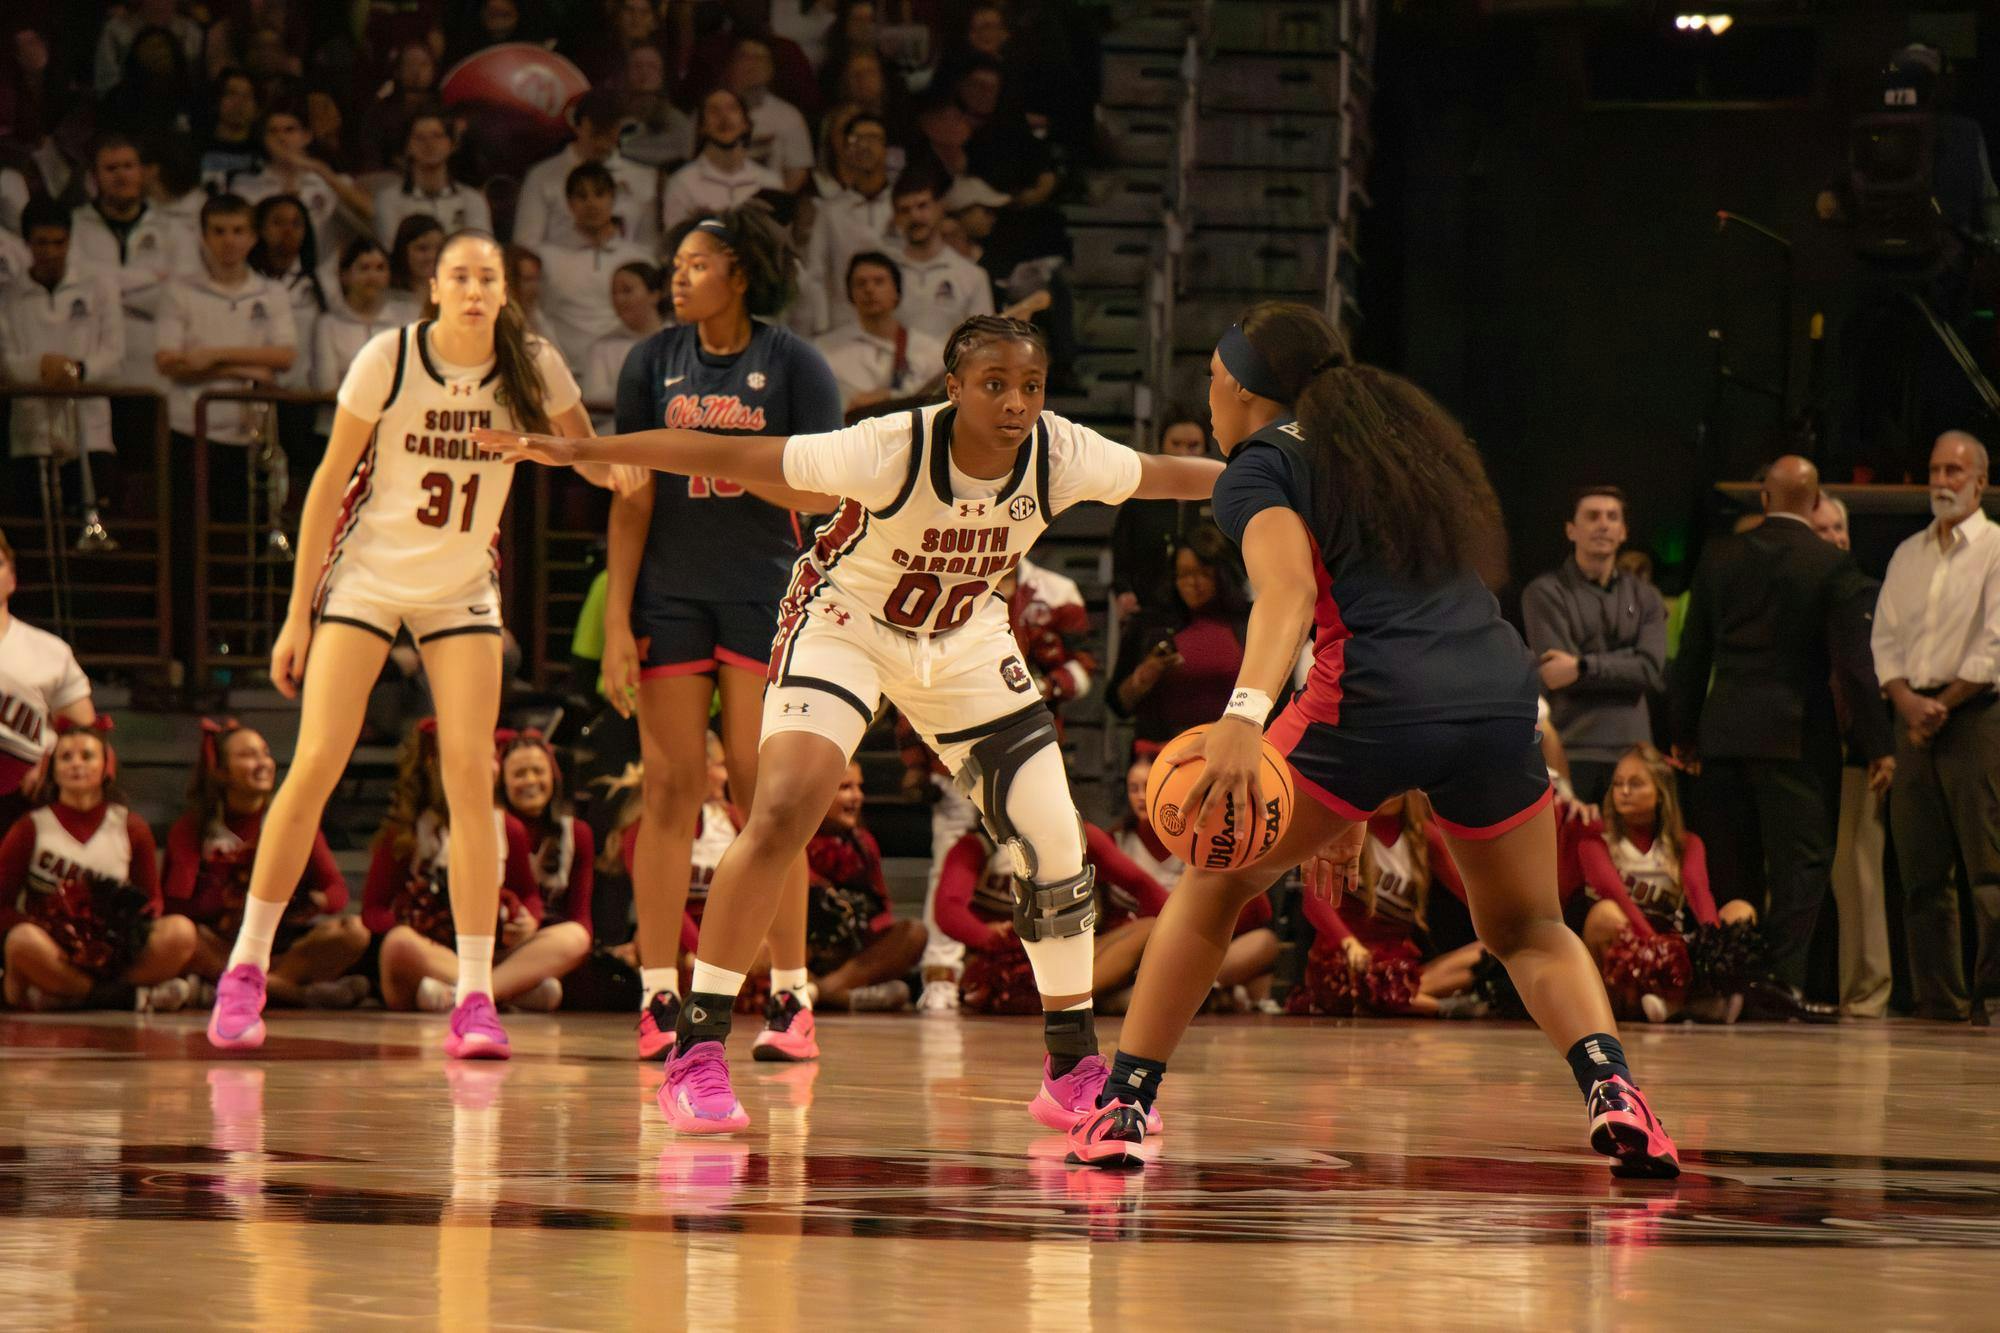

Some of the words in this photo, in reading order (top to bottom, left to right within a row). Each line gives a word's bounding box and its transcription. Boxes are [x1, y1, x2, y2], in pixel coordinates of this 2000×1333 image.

[425, 410, 491, 432] SOUTH
[665, 394, 704, 429] Ole
[701, 394, 767, 431] Miss
[417, 472, 480, 532] 31
[1010, 497, 1034, 520] SEC
[921, 527, 1010, 553] SOUTH
[883, 572, 990, 630] 00
